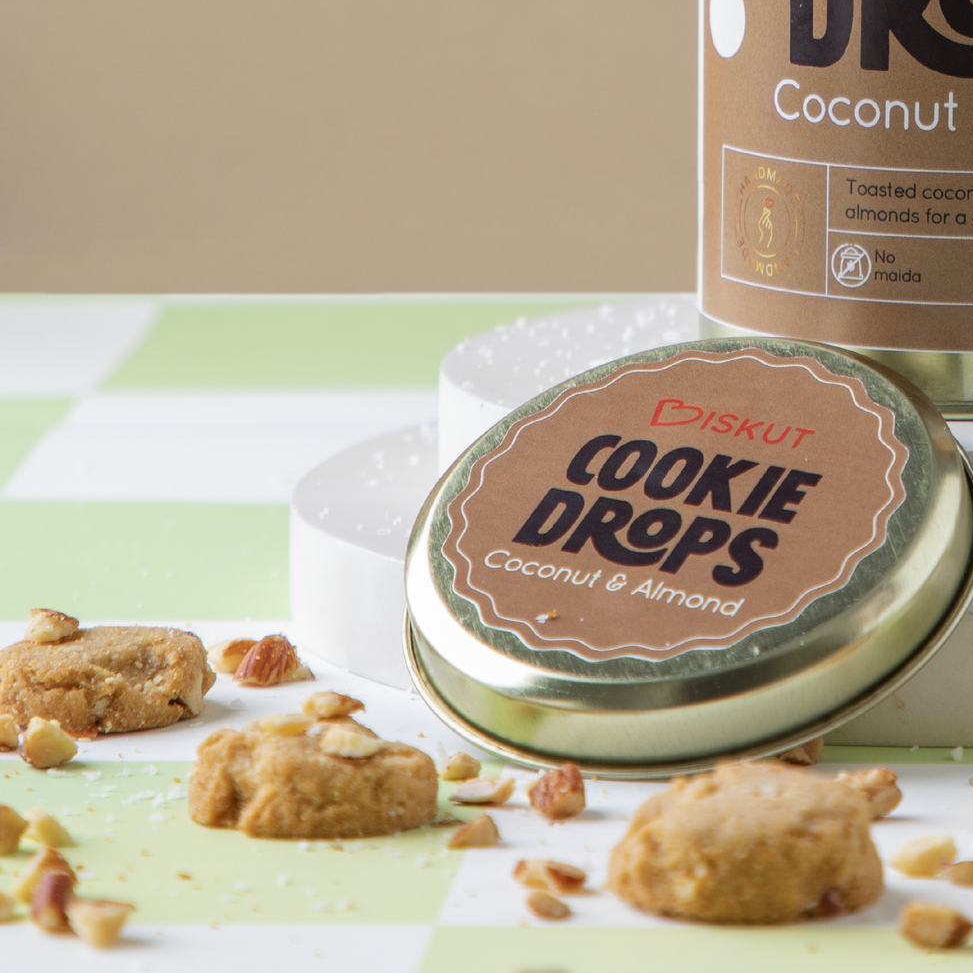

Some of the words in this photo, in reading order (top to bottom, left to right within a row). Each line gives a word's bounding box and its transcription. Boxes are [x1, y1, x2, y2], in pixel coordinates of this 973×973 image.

[773, 79, 957, 131] Coconut
[846, 178, 916, 199] Toasted
[845, 204, 920, 224] almonds
[926, 208, 950, 225] for
[955, 213, 966, 225] a
[874, 269, 922, 283] maida
[875, 249, 896, 264] No
[650, 399, 816, 449] BISKUT
[565, 434, 824, 525] COOKIE
[511, 487, 780, 587] DROPS
[484, 550, 602, 588] Coconut
[606, 574, 627, 592] &
[631, 579, 745, 617] Almond
